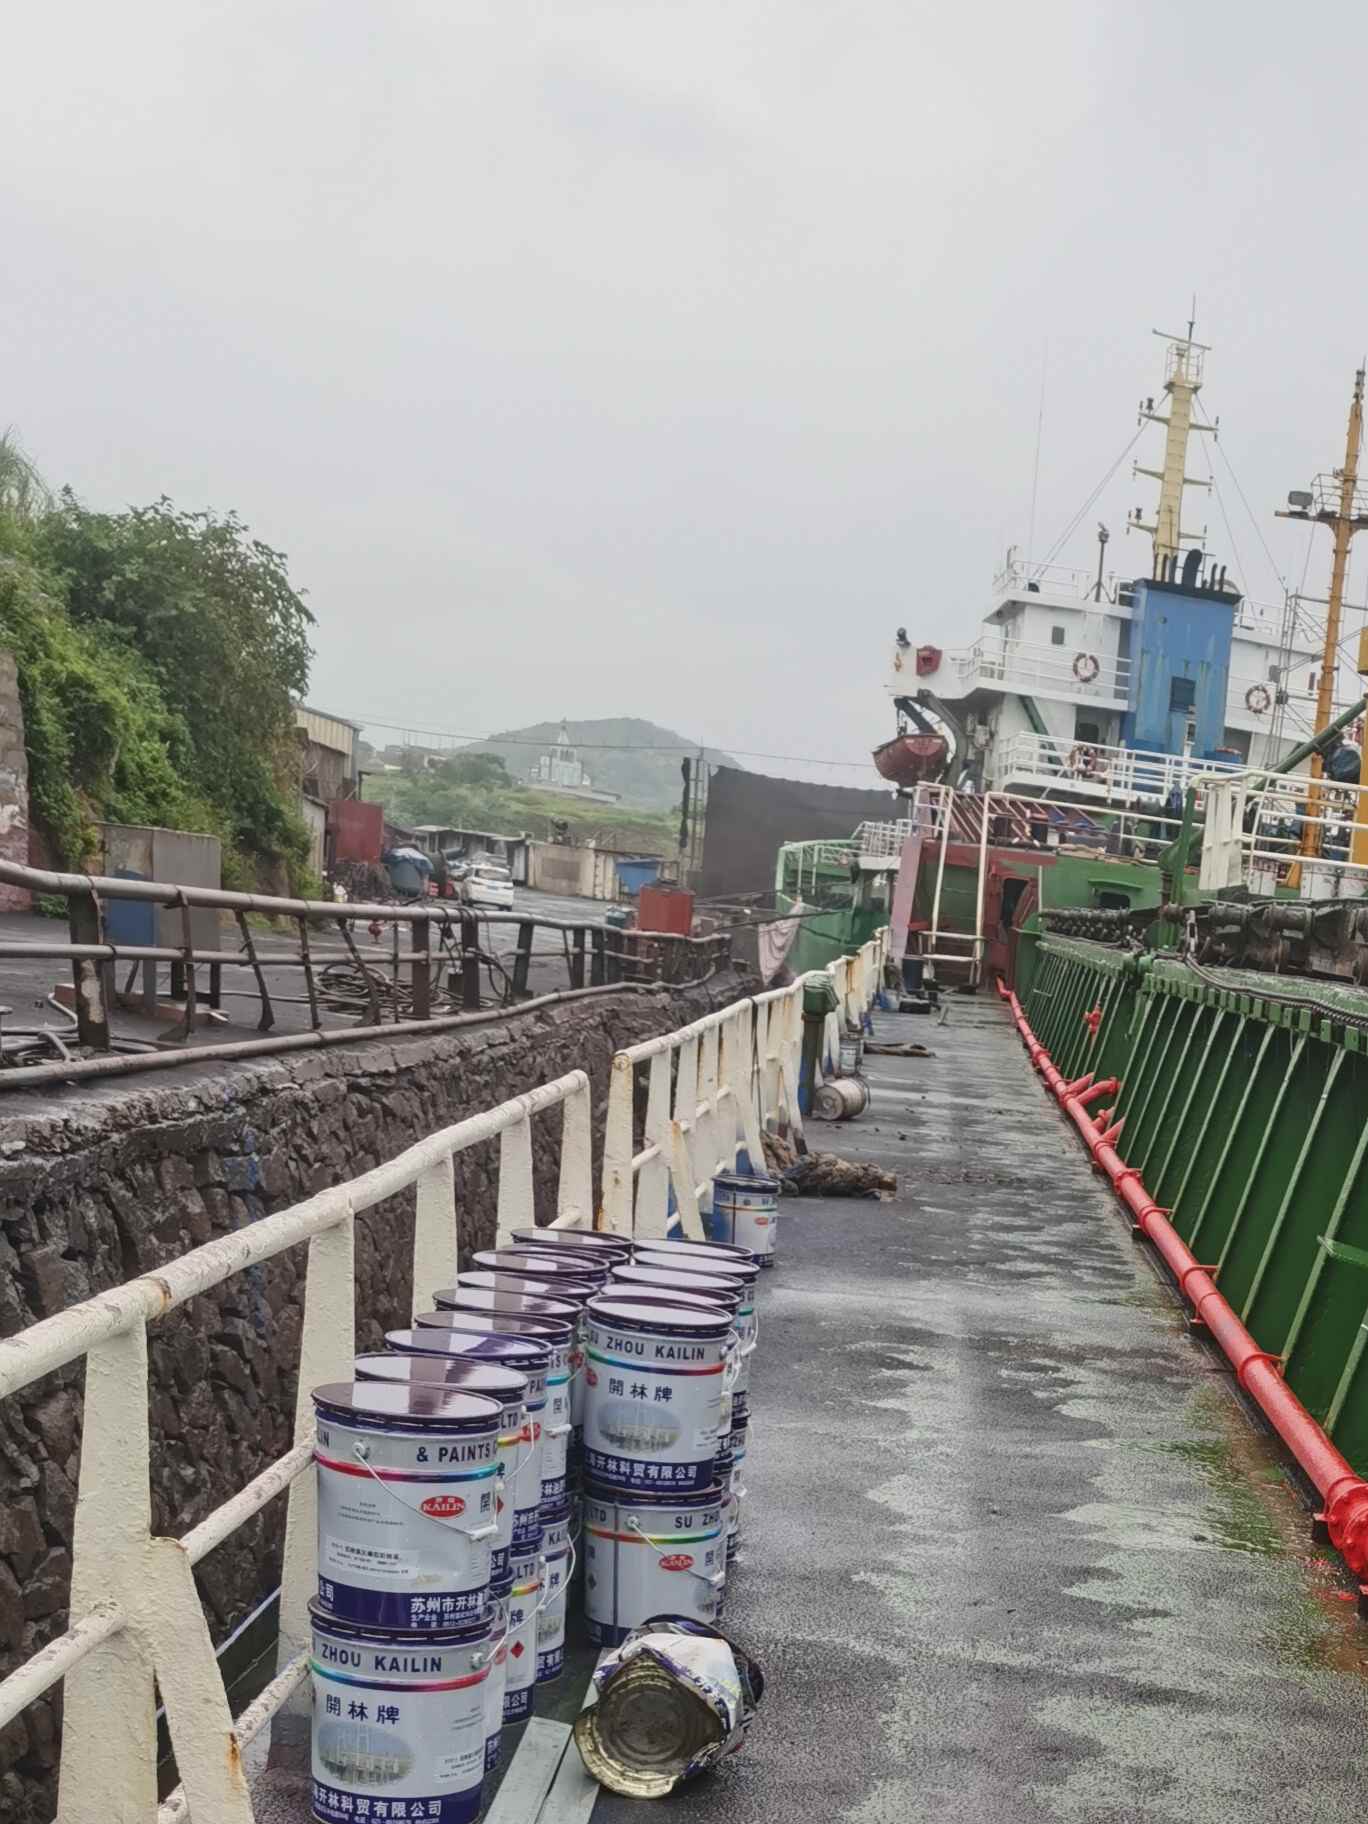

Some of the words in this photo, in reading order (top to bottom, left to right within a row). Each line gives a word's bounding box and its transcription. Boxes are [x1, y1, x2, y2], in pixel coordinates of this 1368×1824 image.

[607, 1336, 645, 1355] ZHOU
[655, 1345, 705, 1360] KAILIN
[609, 1378, 673, 1402] 開林牌
[501, 1412, 519, 1429] LTD
[417, 1446, 429, 1463] &
[438, 1444, 491, 1463] PAINTS
[422, 1503, 465, 1512] KAILIN
[675, 1516, 693, 1529] SU
[321, 1644, 362, 1667] ZHOU
[374, 1656, 442, 1673] KAILIN
[326, 1694, 400, 1725] 開林牌
